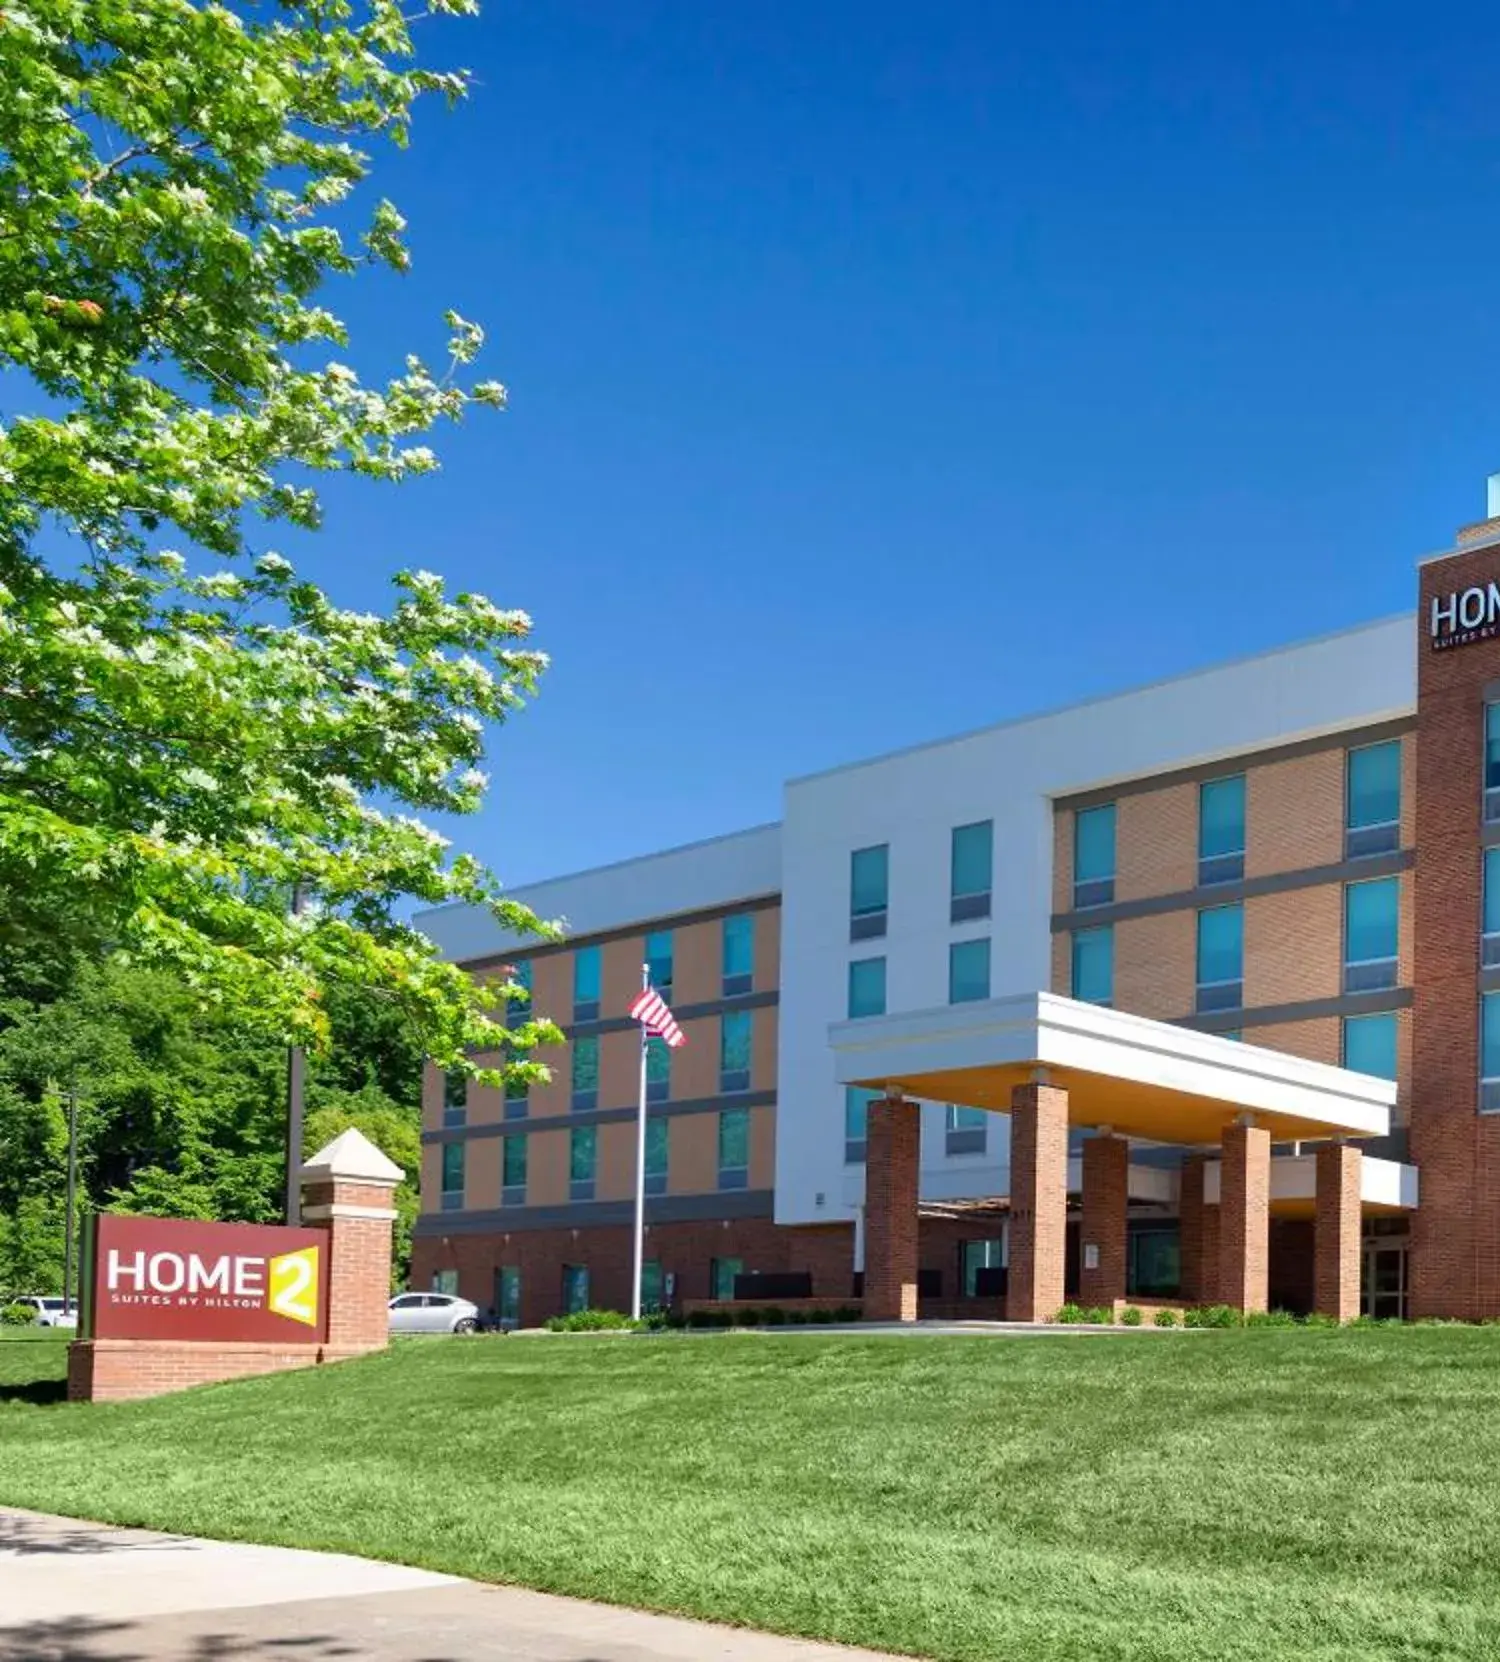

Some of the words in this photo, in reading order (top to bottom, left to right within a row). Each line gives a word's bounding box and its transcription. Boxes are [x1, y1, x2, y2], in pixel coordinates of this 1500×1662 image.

[1433, 631, 1476, 648] SUITES
[1480, 627, 1497, 638] BY
[107, 1249, 265, 1296] HOME
[273, 1256, 313, 1319] 2
[111, 1293, 171, 1305] SUITES
[178, 1296, 199, 1306] BY
[205, 1297, 262, 1309] HILTON
